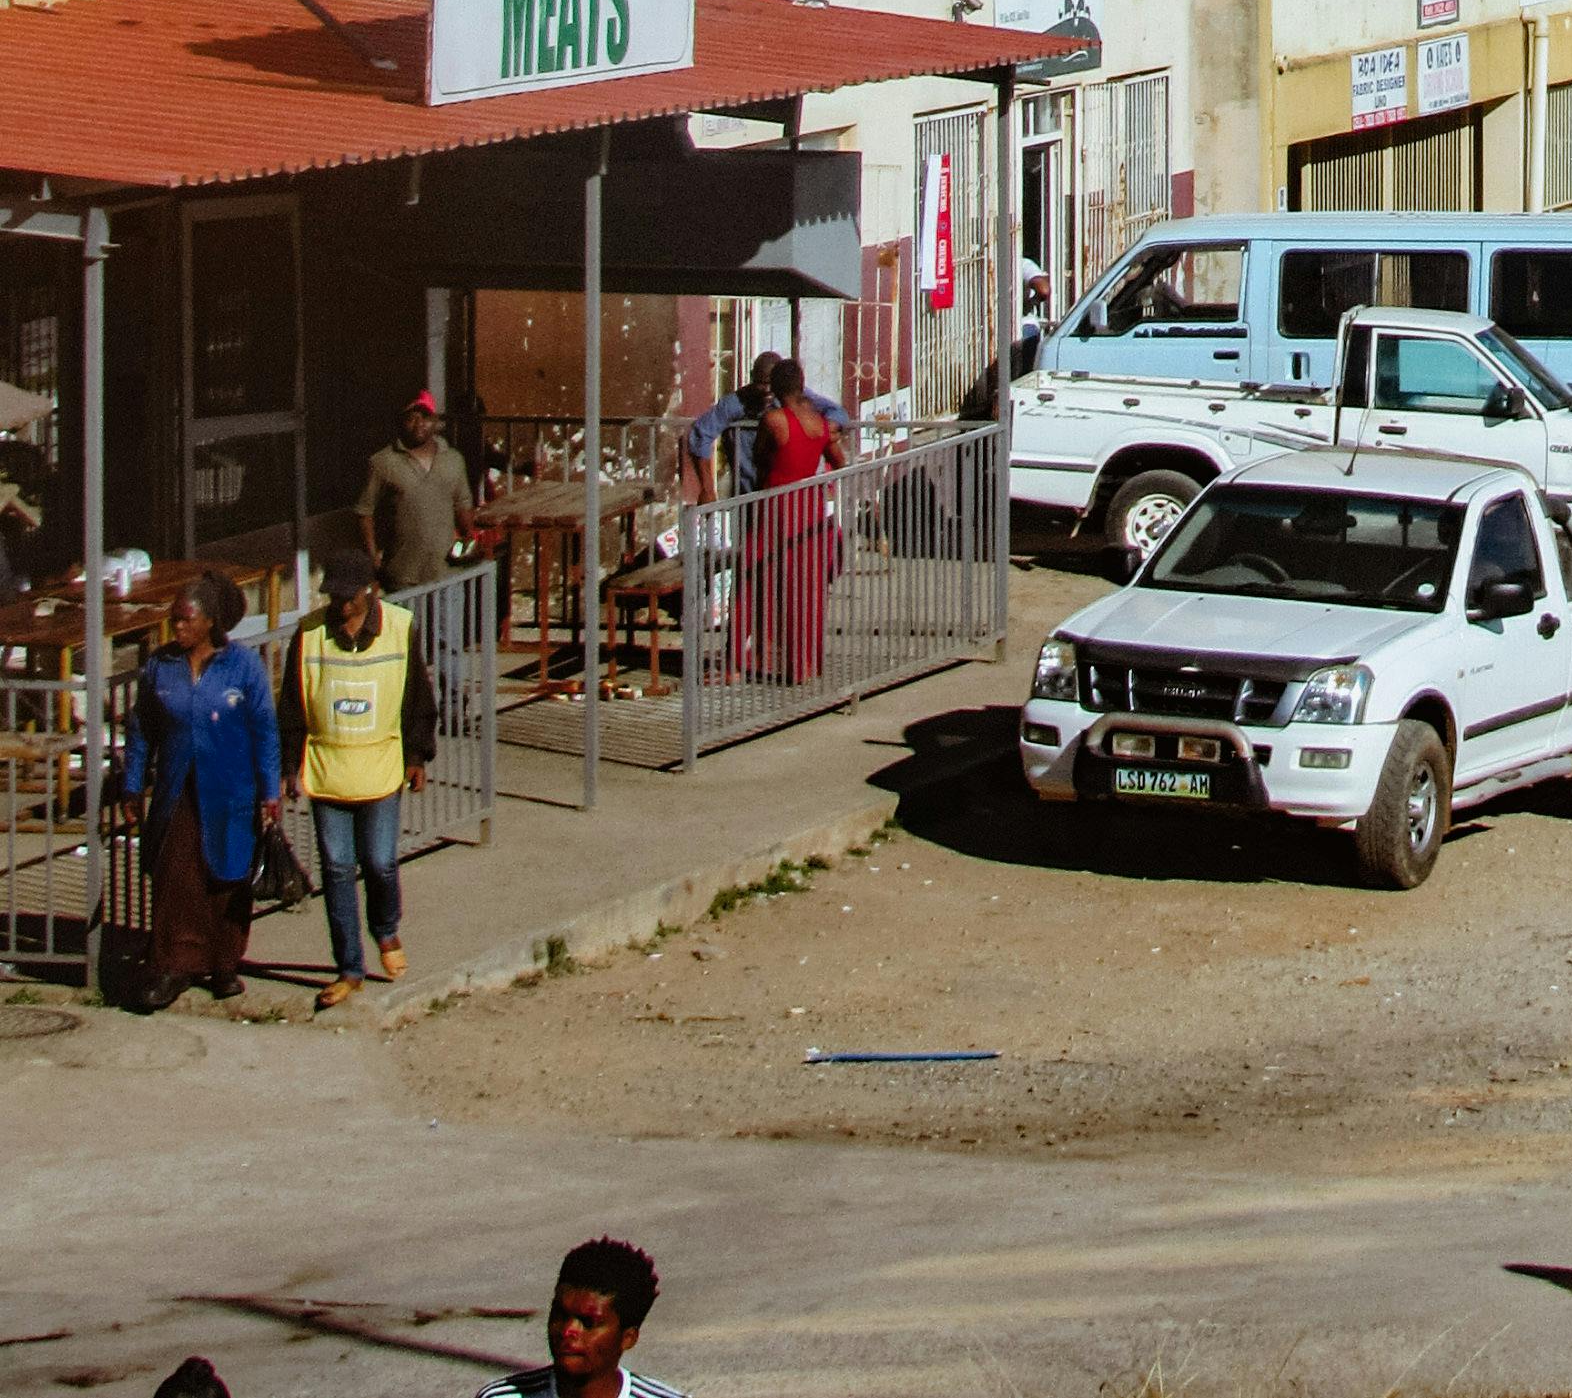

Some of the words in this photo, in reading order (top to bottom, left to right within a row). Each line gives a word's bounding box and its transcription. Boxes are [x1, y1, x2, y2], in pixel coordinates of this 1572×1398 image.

[340, 700, 368, 714] MTN
[1118, 769, 1146, 791] LSD
[1149, 770, 1177, 792] 762
